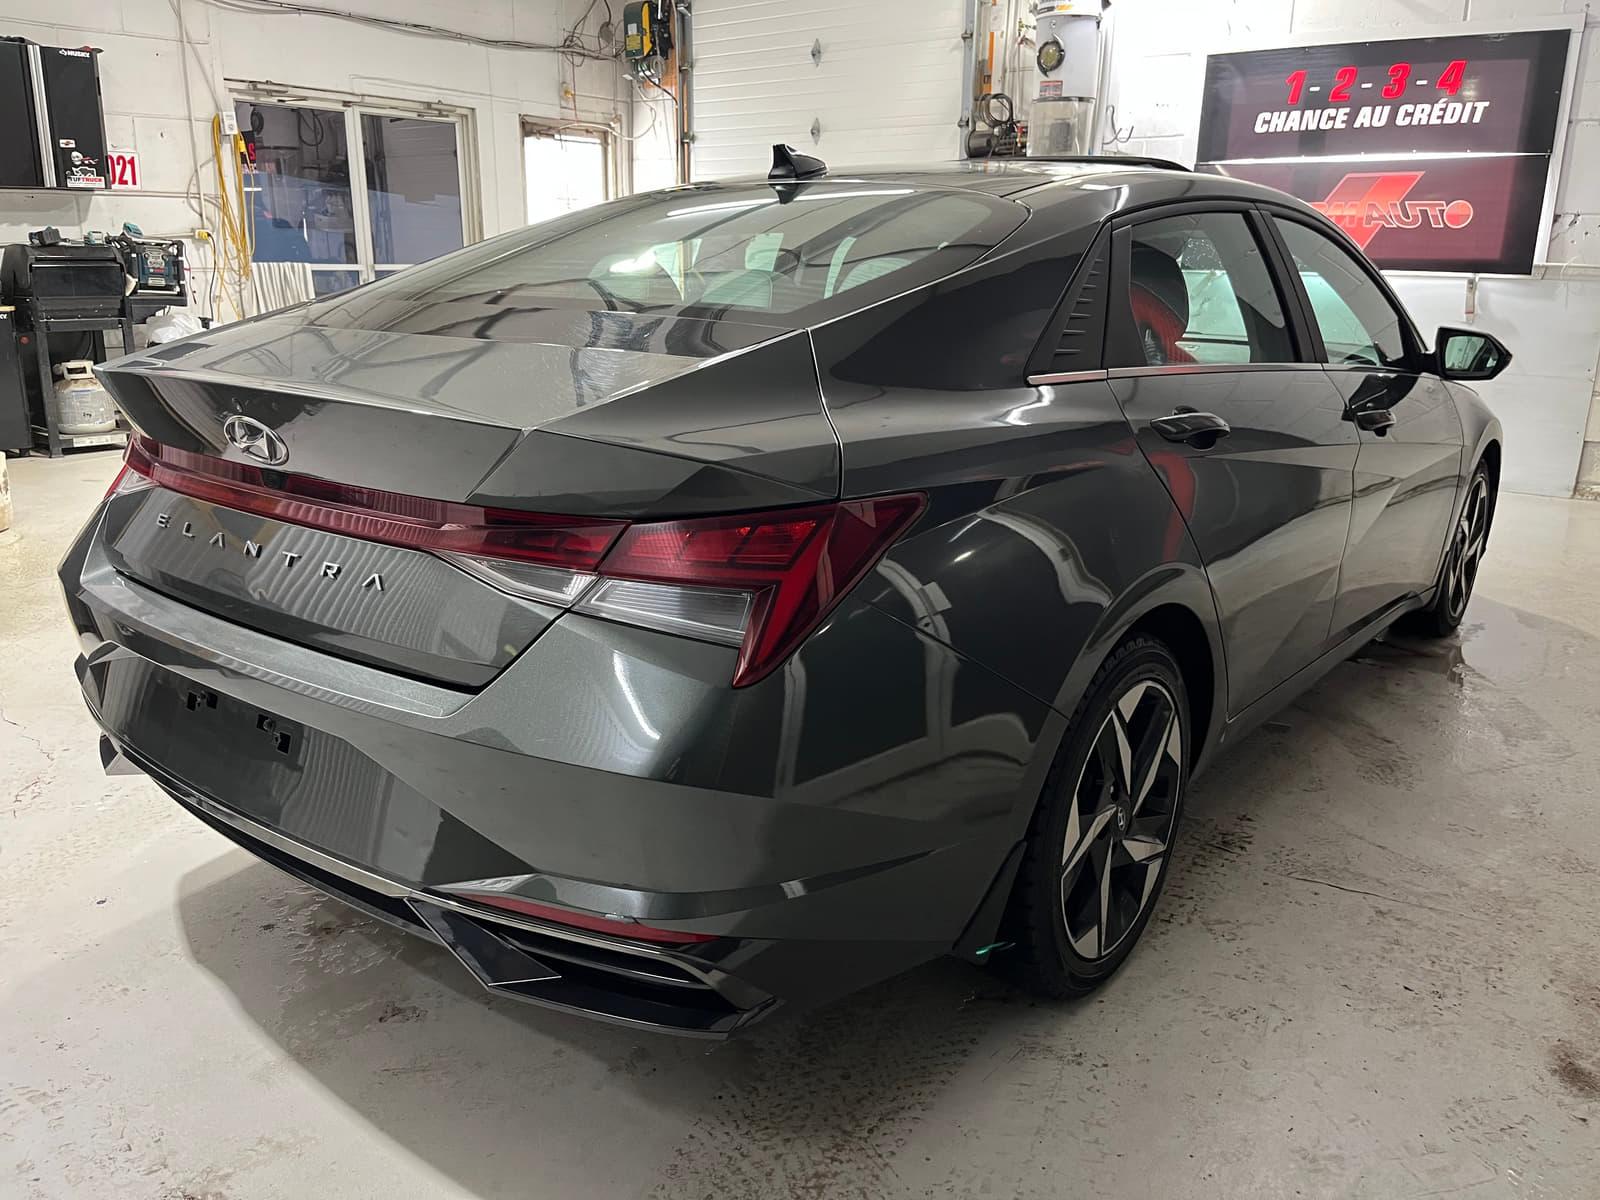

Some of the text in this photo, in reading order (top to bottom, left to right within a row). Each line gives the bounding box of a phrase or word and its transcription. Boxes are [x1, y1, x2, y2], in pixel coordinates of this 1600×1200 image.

[1254, 98, 1490, 134] CHANCE AU CRÉDIT
[157, 513, 384, 592] ELANTRA
